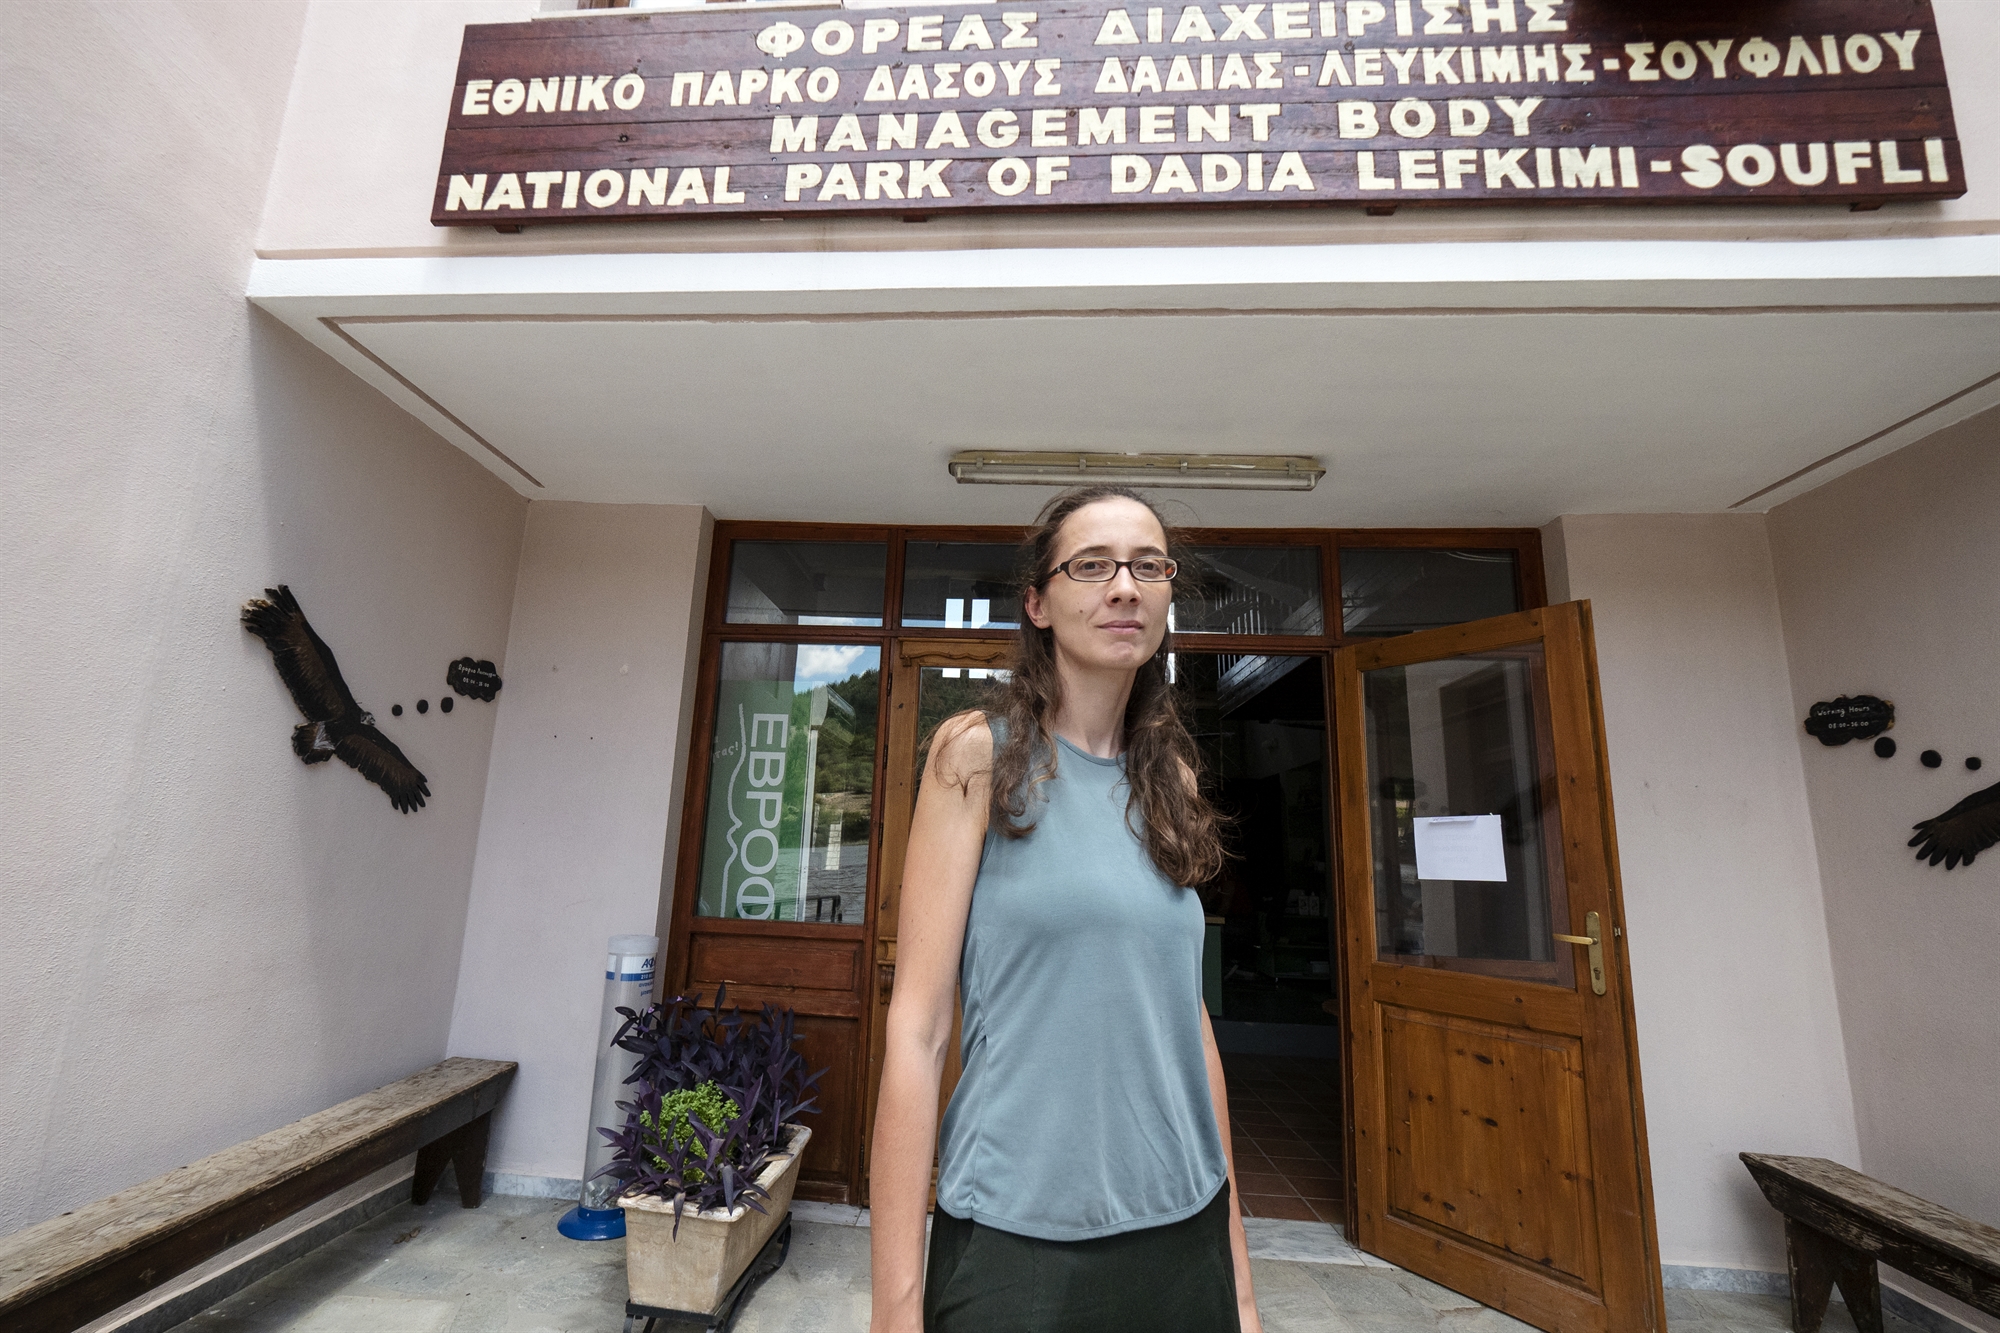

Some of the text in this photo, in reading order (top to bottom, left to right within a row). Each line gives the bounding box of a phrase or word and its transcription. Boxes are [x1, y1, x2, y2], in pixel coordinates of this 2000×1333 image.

[755, 0, 1568, 58] ΦΟΡΕΑΣ ΔΙΑΧΕΙΡΙΣΗΣ
[461, 74, 646, 116] ΕΘΝΙΚΟ
[669, 66, 840, 107] ΠΑΡΚΟ
[862, 59, 1063, 102] ΔΑΣΟΥΣ
[769, 95, 1544, 153] MANAGEMENT BODY
[445, 166, 746, 211] NATIONAL
[784, 159, 953, 202] PARK
[986, 156, 1071, 197] OF
[1110, 151, 1316, 195] DADIA
